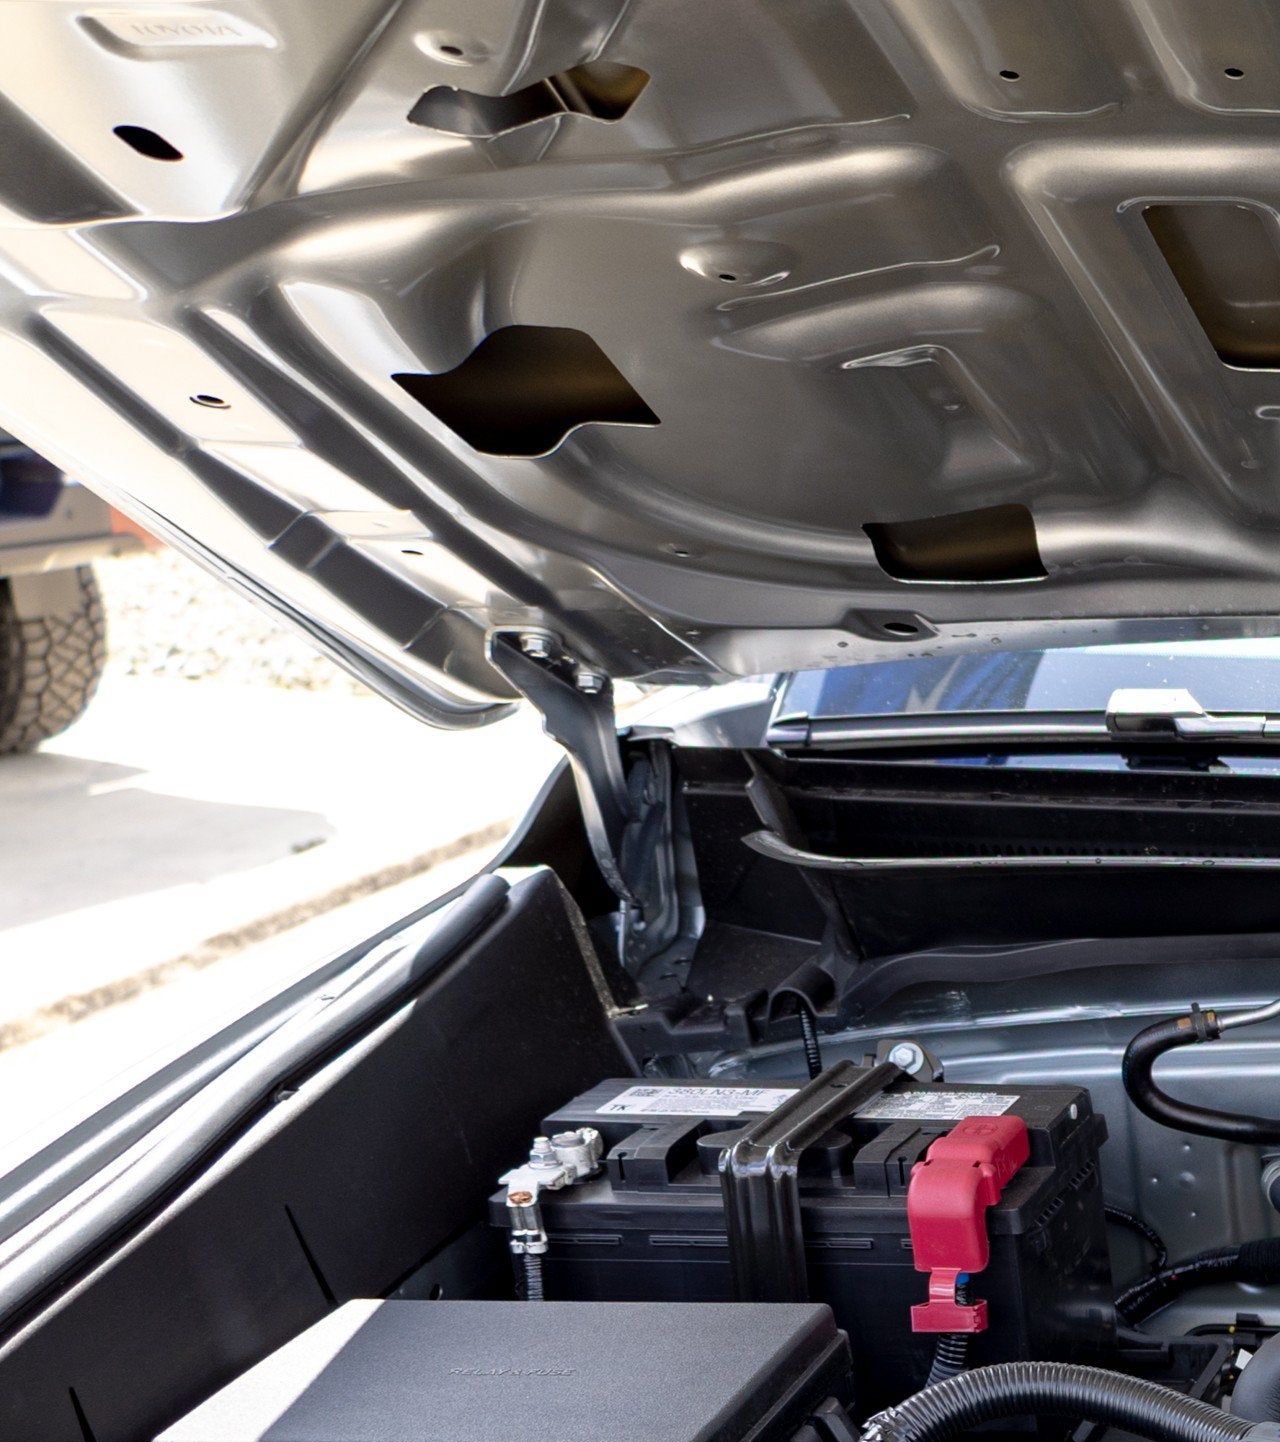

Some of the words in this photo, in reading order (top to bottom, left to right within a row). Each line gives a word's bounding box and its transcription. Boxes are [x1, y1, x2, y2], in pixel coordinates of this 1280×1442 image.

[609, 1103, 631, 1112] TK
[449, 1367, 511, 1376] RELAY
[525, 1368, 577, 1377] FUSE
